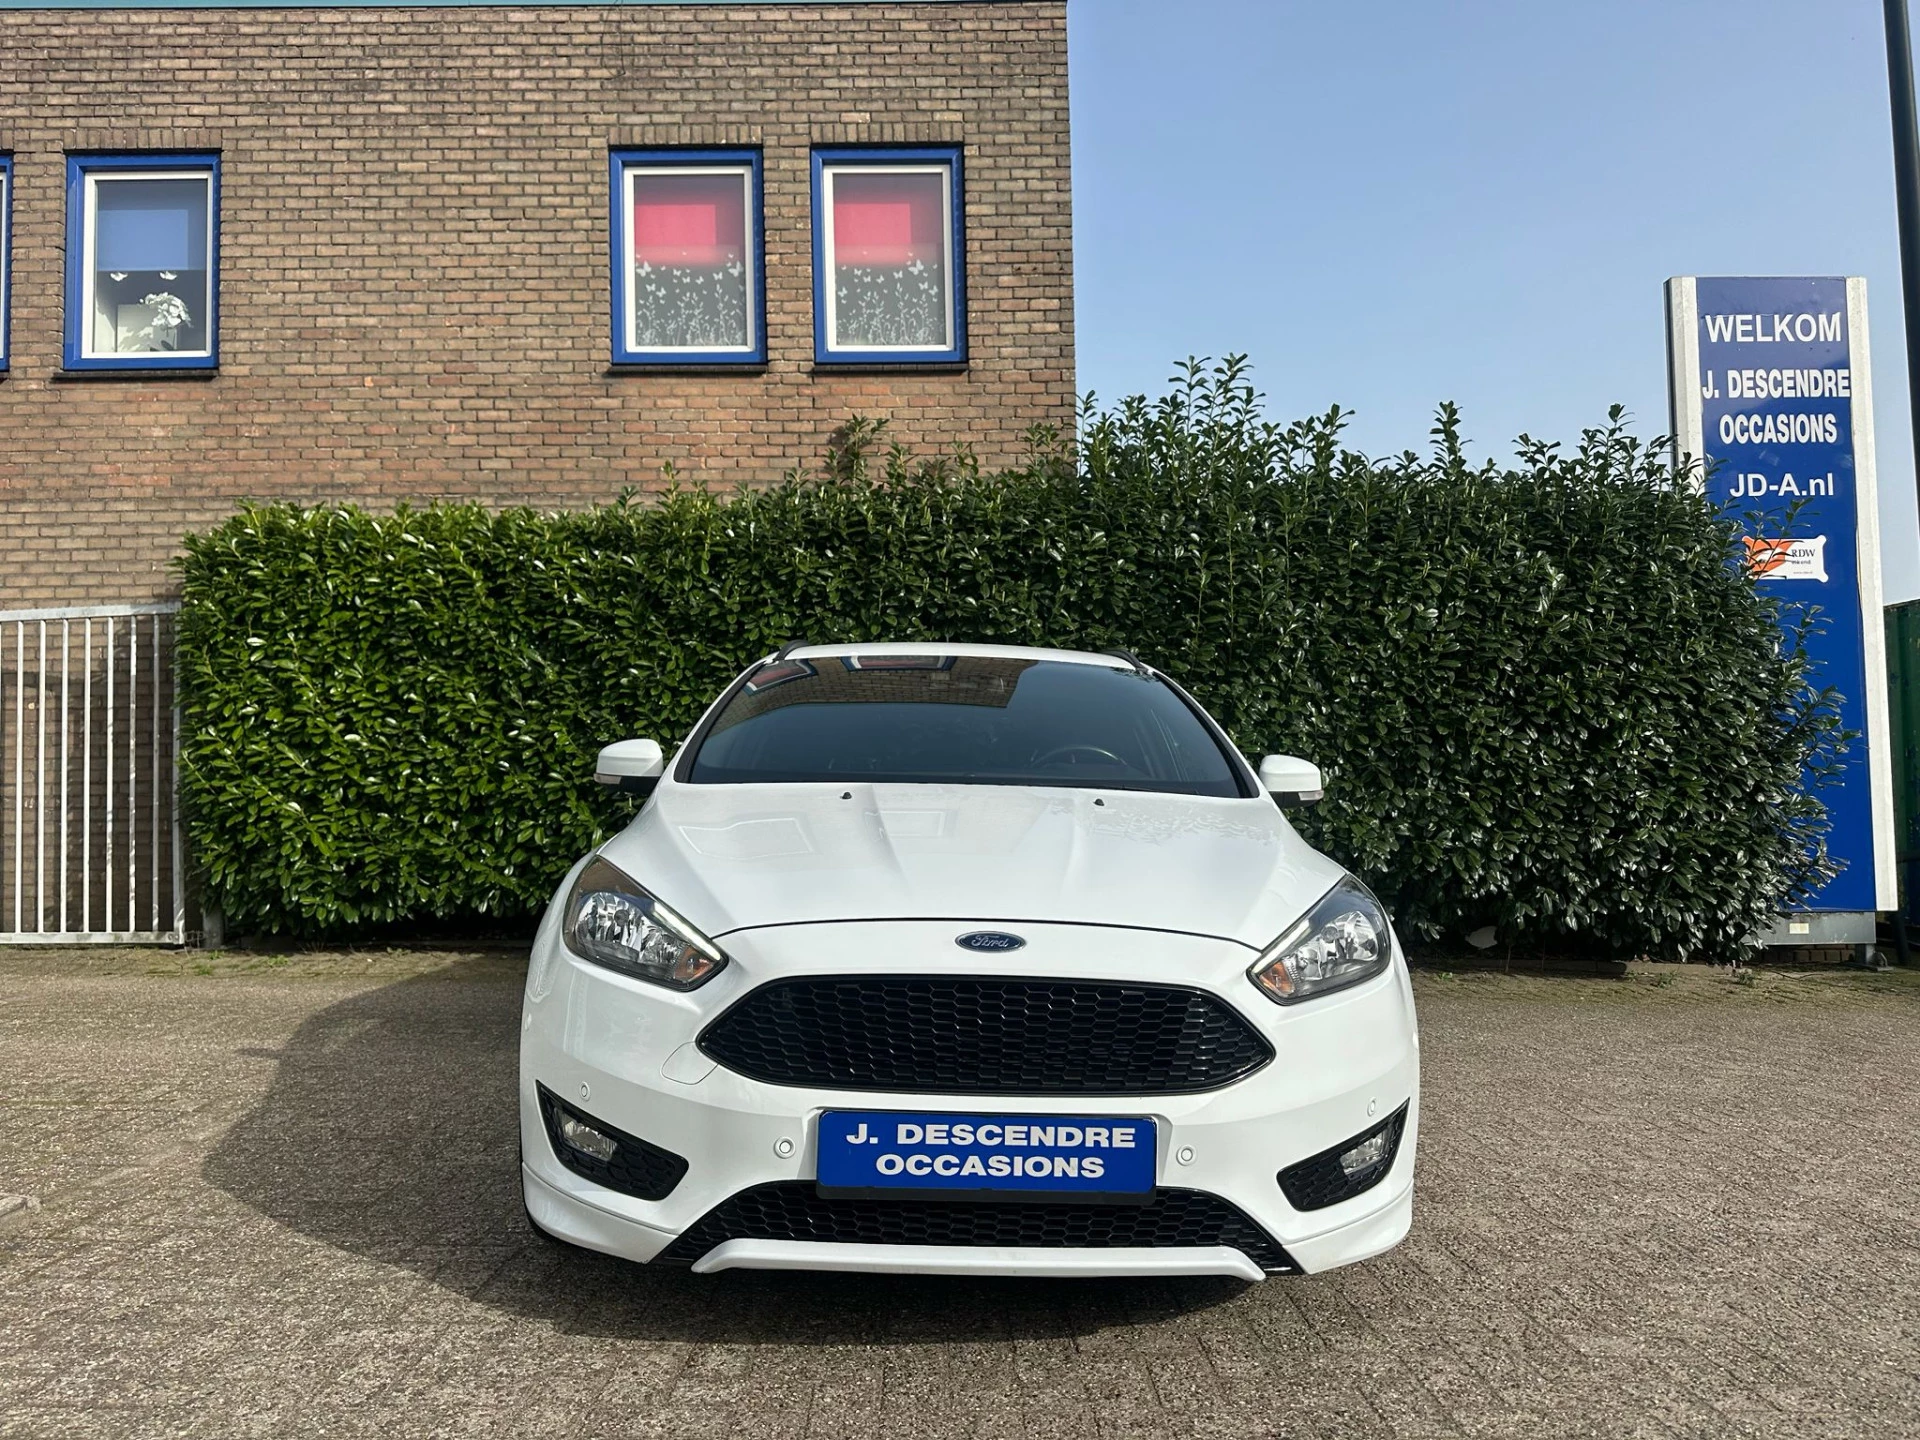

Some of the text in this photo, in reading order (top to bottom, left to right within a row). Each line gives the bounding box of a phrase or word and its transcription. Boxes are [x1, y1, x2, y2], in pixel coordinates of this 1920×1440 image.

[1705, 313, 1842, 342] WELKOM
[1702, 369, 1850, 398] J. DESCENDRE
[1719, 413, 1838, 444] OCCASIONS
[1730, 473, 1834, 497] JD-A.nl
[1791, 549, 1815, 558] RDW
[971, 934, 1009, 948] Ford
[846, 1123, 1136, 1148] J. DESCENDRE
[875, 1154, 1105, 1178] OCCASIONS
